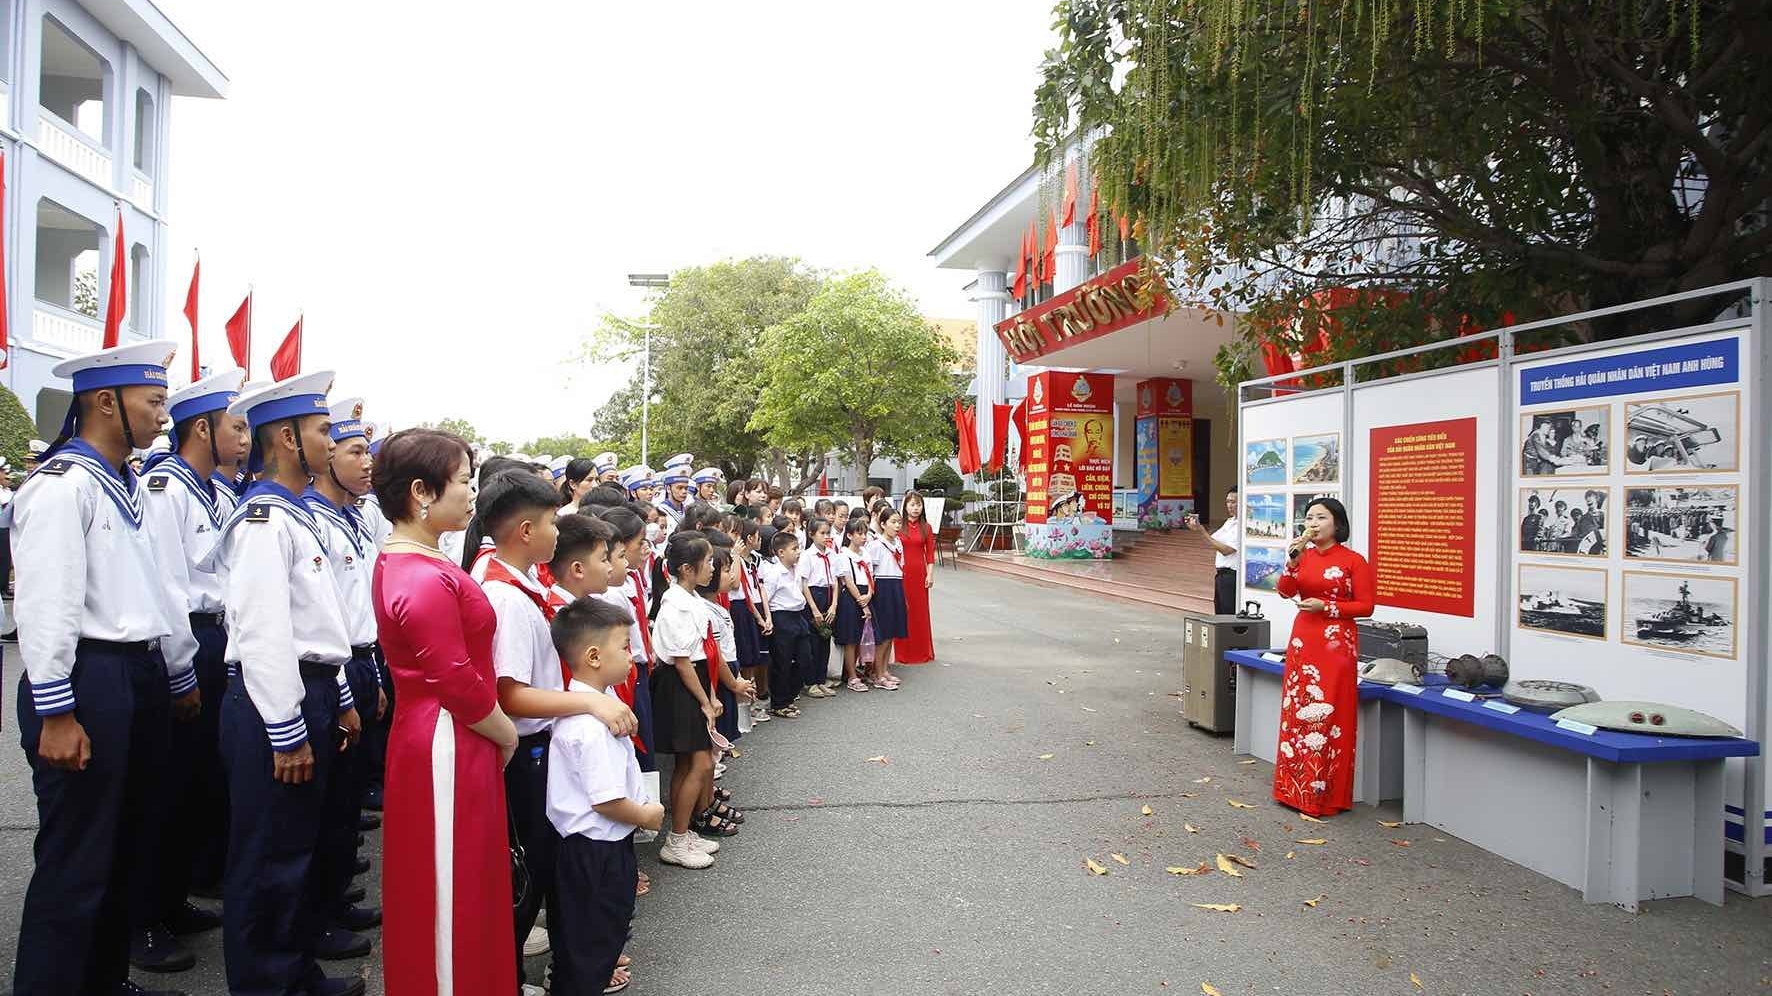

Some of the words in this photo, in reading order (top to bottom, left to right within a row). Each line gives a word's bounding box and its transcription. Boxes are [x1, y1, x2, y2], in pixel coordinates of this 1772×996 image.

[1003, 316, 1046, 357] HỘI
[1530, 376, 1553, 392] TRUYỀN
[1553, 373, 1574, 389] THỐNG
[1575, 371, 1587, 388] HẢI
[1587, 370, 1606, 387] QUÂN
[1607, 367, 1627, 383] NHÂN
[1628, 365, 1644, 380] DÂN
[1645, 363, 1661, 380] VIỆT
[1662, 362, 1681, 376] NAM
[1681, 359, 1699, 373] ANH
[1700, 355, 1724, 371] HÙNG
